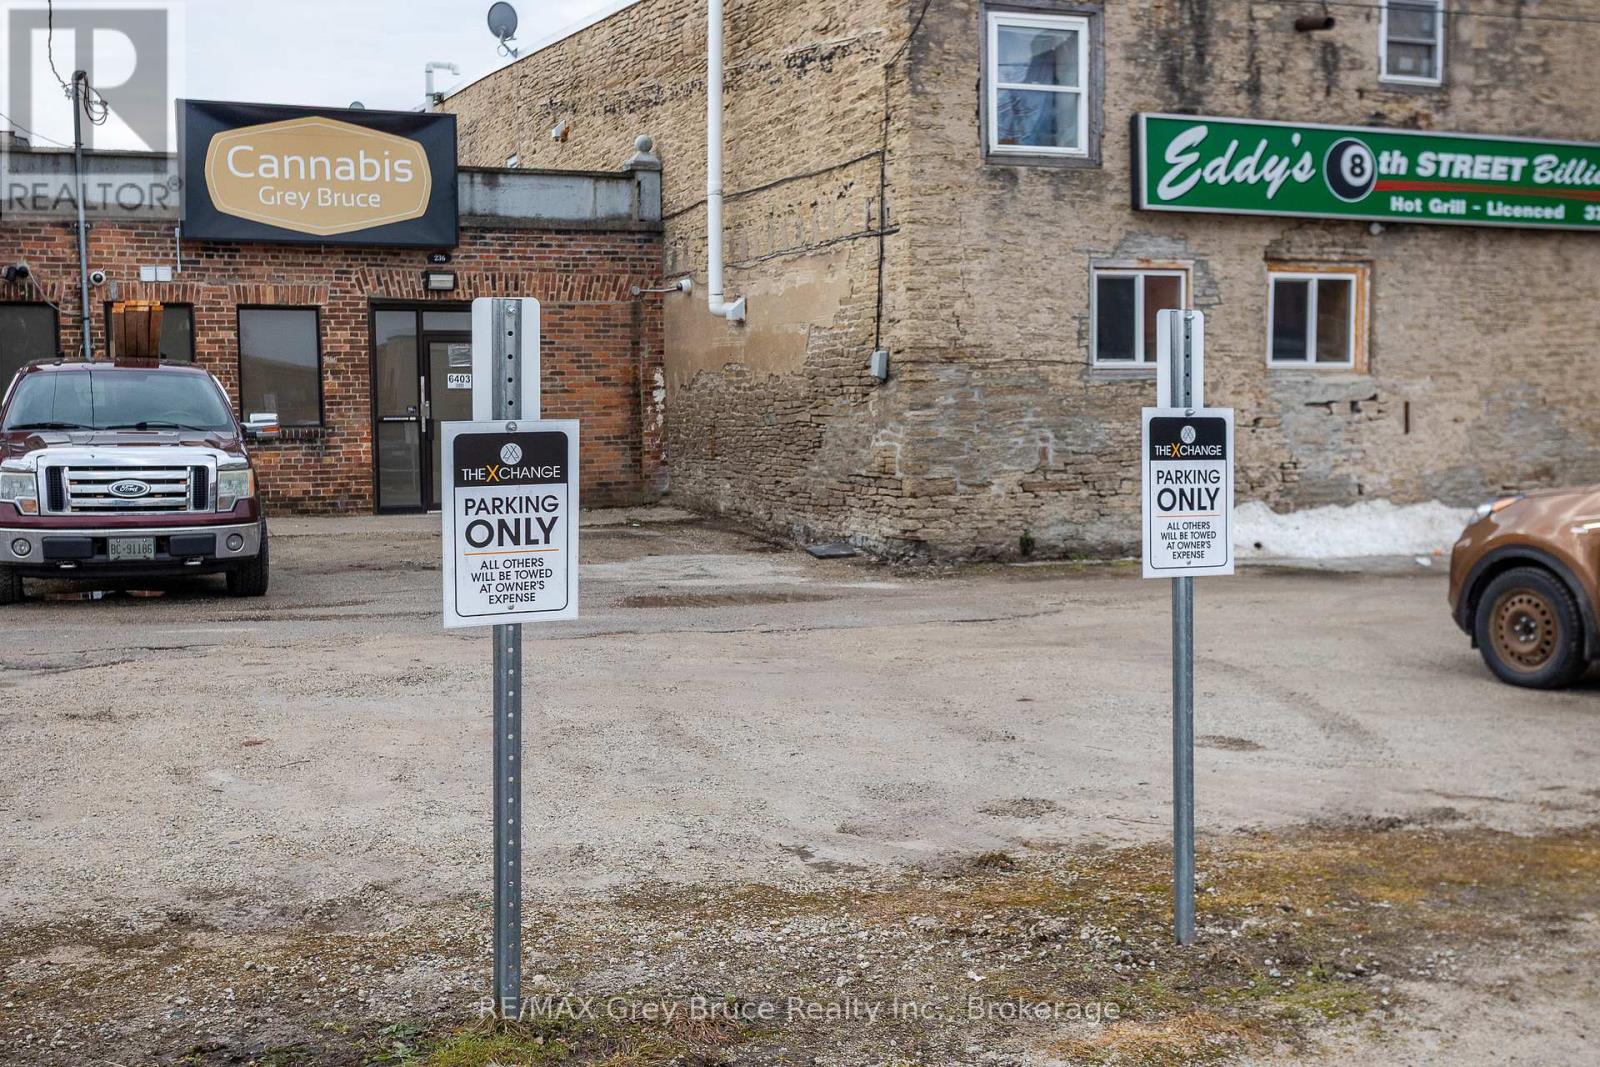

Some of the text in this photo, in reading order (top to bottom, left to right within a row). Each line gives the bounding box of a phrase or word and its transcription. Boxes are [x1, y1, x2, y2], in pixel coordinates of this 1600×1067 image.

[227, 145, 413, 183] Cannabis
[1157, 124, 1316, 201] Eddy's
[1416, 152, 1528, 181] STREET
[259, 185, 380, 210] Grey Bruce
[1391, 197, 1422, 213] Hot
[1430, 198, 1465, 214] Grill
[1487, 200, 1565, 220] Licenced
[449, 375, 470, 383] 6403
[1157, 470, 1220, 485] PARKING
[465, 495, 559, 515] PARKING
[1157, 488, 1220, 511] ONLY
[465, 516, 559, 548] ONLY
[1167, 521, 1210, 530] ALL OTHERS
[1161, 531, 1216, 540] WILL BE TOWED
[1166, 541, 1211, 549] AT OWNER'S
[1172, 551, 1205, 560] EXPENSE
[481, 558, 544, 570] ALL OTHERS
[471, 569, 552, 582] WILL BE TOWED
[480, 580, 544, 594] AT OWNER'S
[489, 593, 535, 604] EXPENSE
